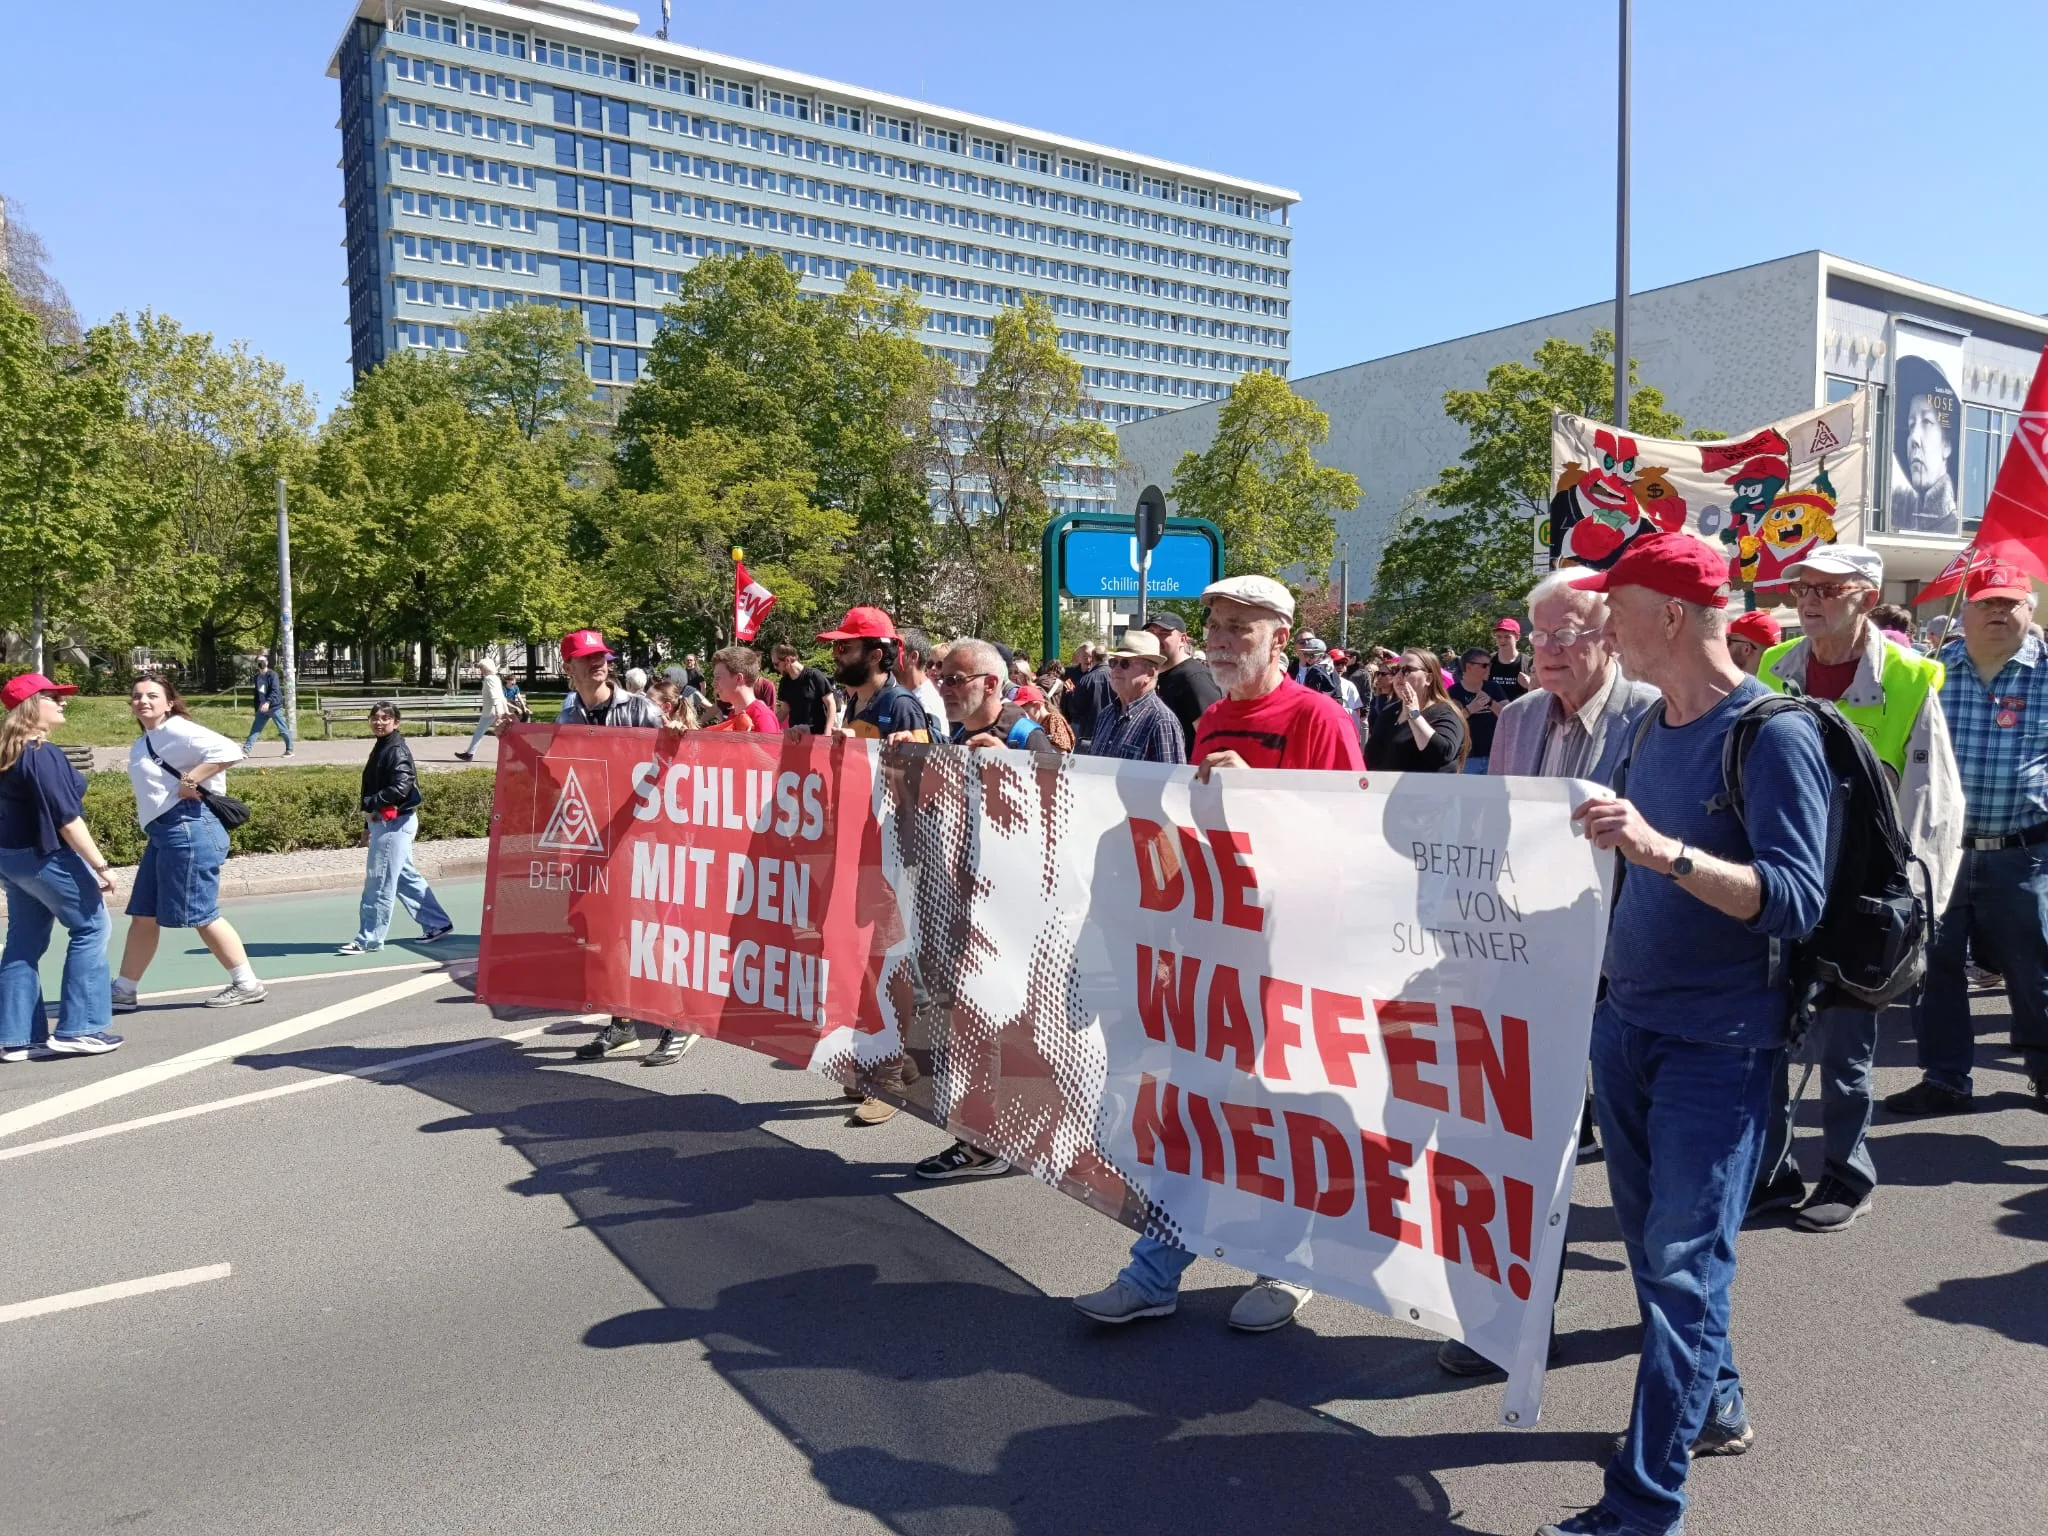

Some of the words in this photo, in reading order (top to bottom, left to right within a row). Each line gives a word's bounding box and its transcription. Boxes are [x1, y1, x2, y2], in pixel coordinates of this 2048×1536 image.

[1927, 394, 1953, 412] ROSE
[1130, 536, 1152, 573] U
[1101, 576, 1180, 592] Schillinstraße
[632, 761, 824, 841] SCHLUSS
[529, 861, 609, 895] BERLIN
[1129, 817, 1264, 932] DIE
[1411, 841, 1516, 884] BERTHA
[631, 841, 716, 909] MIT
[726, 853, 810, 929] DEN
[1456, 888, 1522, 923] VON
[1391, 921, 1530, 965] SUTTNER
[629, 919, 831, 1030] KRIEGEN!
[1136, 943, 1534, 1140] WAFFEN
[1131, 1073, 1534, 1301] NIEDER!
